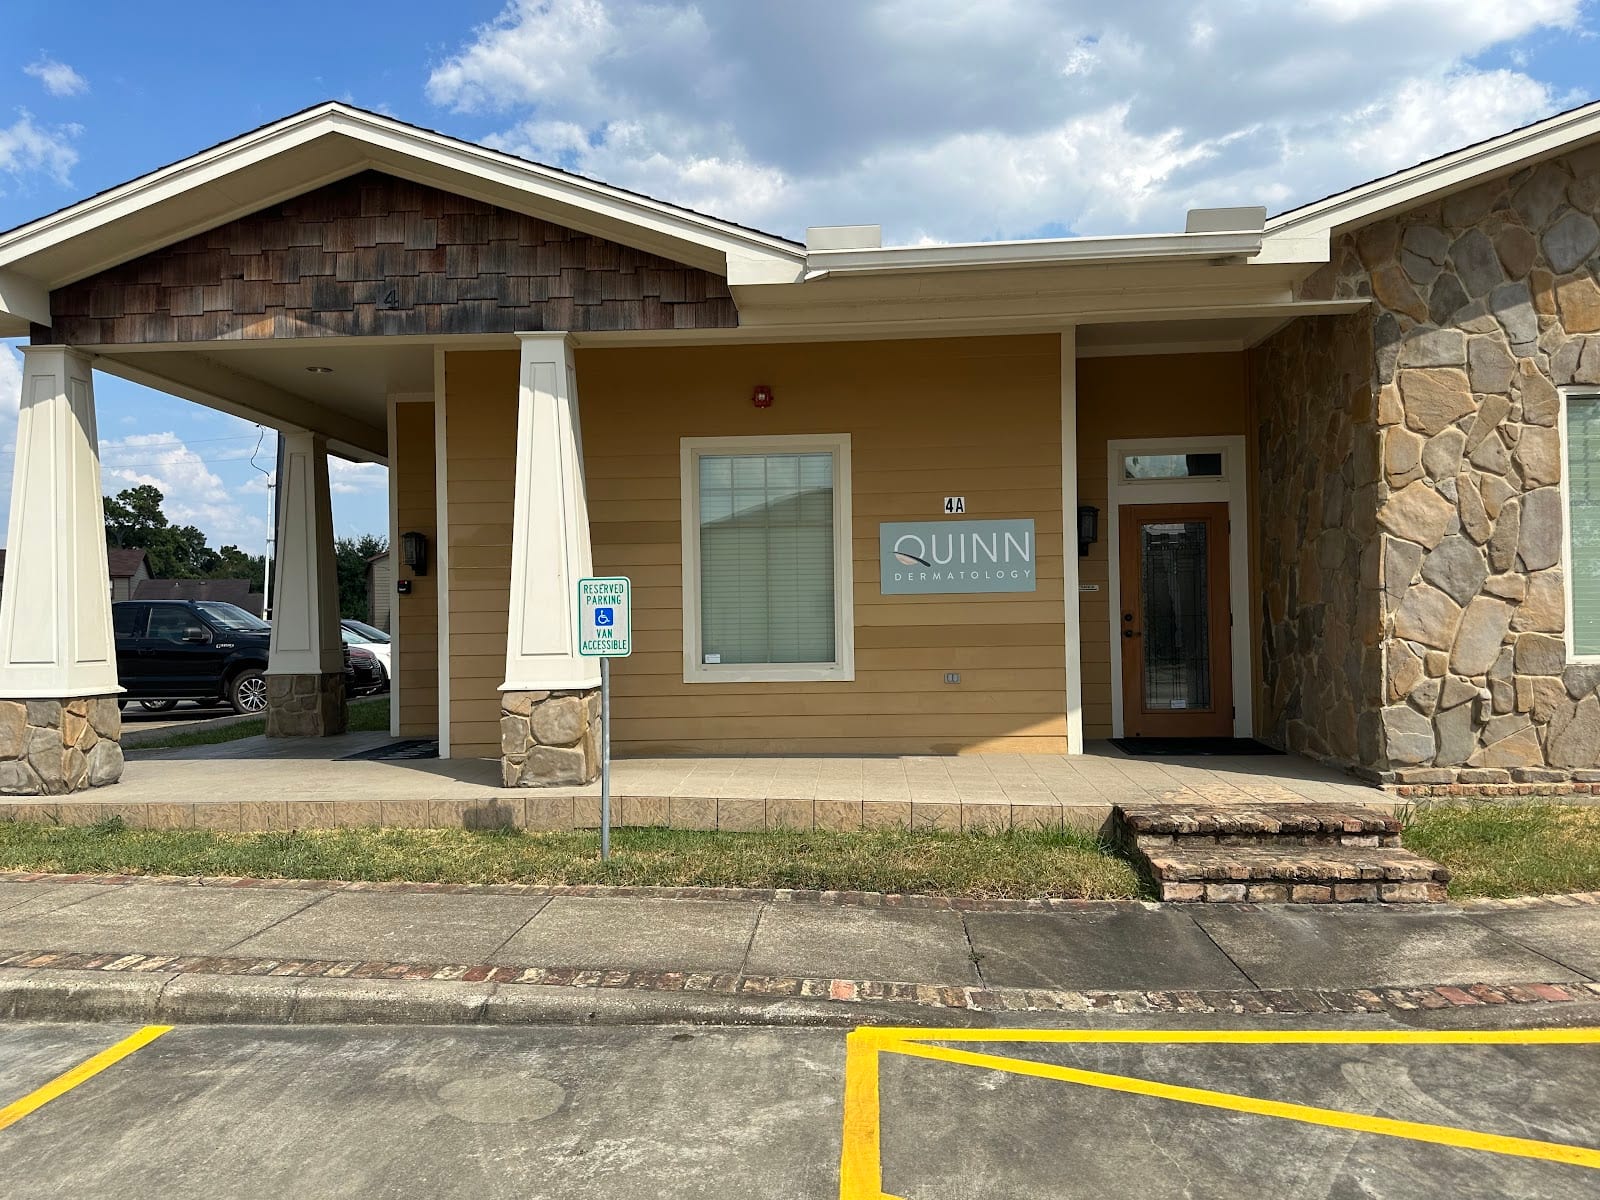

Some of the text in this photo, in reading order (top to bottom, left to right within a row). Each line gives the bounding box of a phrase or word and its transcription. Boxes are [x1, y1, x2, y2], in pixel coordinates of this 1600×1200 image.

[383, 289, 398, 308] 4
[945, 498, 964, 512] 4A
[892, 532, 1030, 566] QUINN
[894, 571, 1030, 580] DERMATOLOGY
[584, 584, 623, 593] RESERVED
[587, 595, 621, 604] PARKING
[597, 629, 612, 638] VAN
[583, 640, 626, 649] ACCESSIBLE
